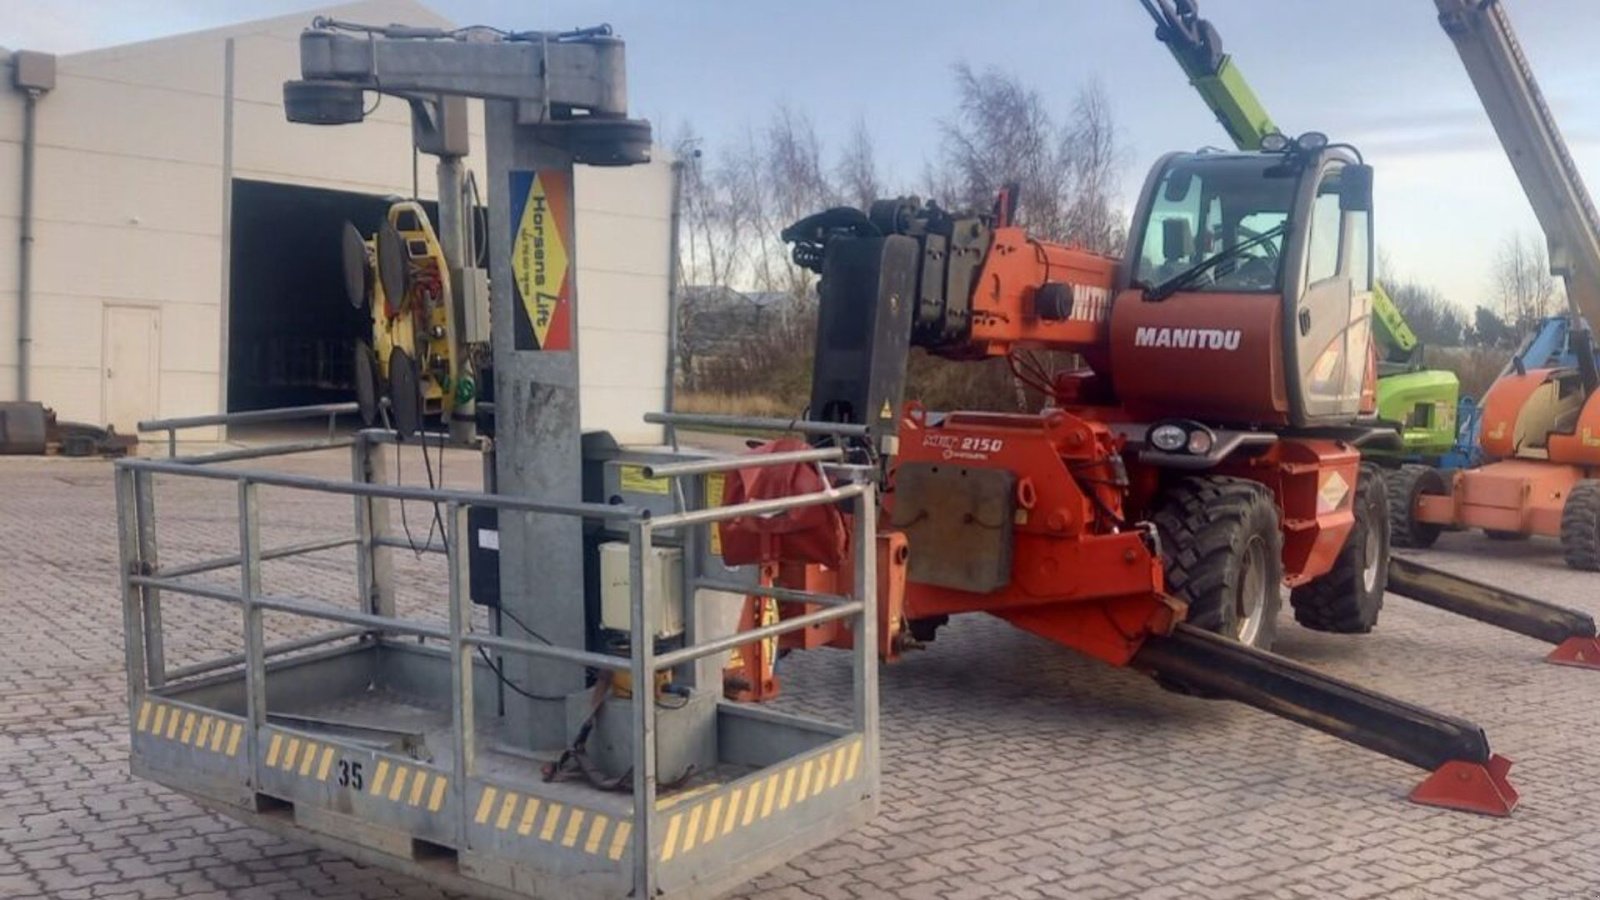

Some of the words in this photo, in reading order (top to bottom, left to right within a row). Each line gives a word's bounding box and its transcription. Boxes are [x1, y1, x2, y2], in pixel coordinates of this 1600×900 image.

[533, 196, 547, 287] Horsens
[536, 291, 559, 327] Lift
[1134, 326, 1241, 350] MANITOU
[960, 436, 1004, 453] 2150
[338, 759, 363, 791] 35
